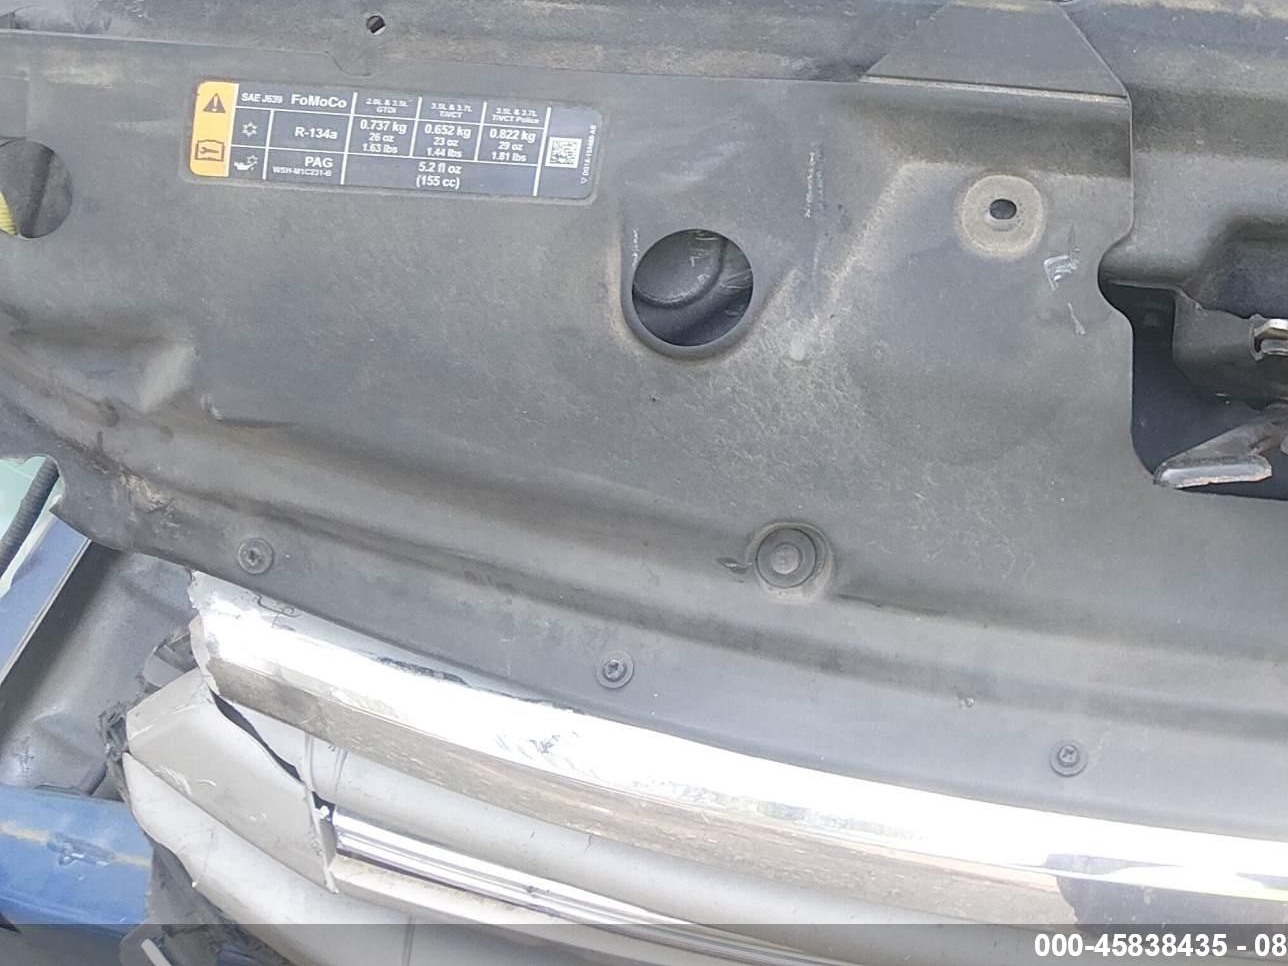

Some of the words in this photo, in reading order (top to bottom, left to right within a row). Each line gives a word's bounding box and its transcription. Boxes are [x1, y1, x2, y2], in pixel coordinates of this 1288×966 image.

[241, 93, 261, 102] SAE
[291, 94, 347, 108] FoMoCo
[360, 119, 390, 131] 0.737
[392, 122, 407, 134] kg
[425, 124, 454, 135] 0.652
[457, 126, 471, 138] kg
[295, 127, 337, 139] R-134a
[369, 133, 380, 141] 26
[490, 129, 519, 139] 0.822
[521, 130, 536, 143] kg
[362, 143, 381, 152] 1.63
[384, 145, 398, 153] lbs
[433, 137, 445, 145] 23
[447, 139, 459, 147] oz
[498, 141, 510, 150] 29
[427, 147, 445, 157] 1.44
[448, 148, 462, 158] lbs
[512, 153, 527, 162] lbs
[305, 156, 333, 168] PAG
[418, 162, 434, 172] 5.2
[438, 163, 445, 173] fl
[448, 166, 462, 174] oz
[416, 175, 440, 187] (155
[442, 177, 460, 189] cc)
